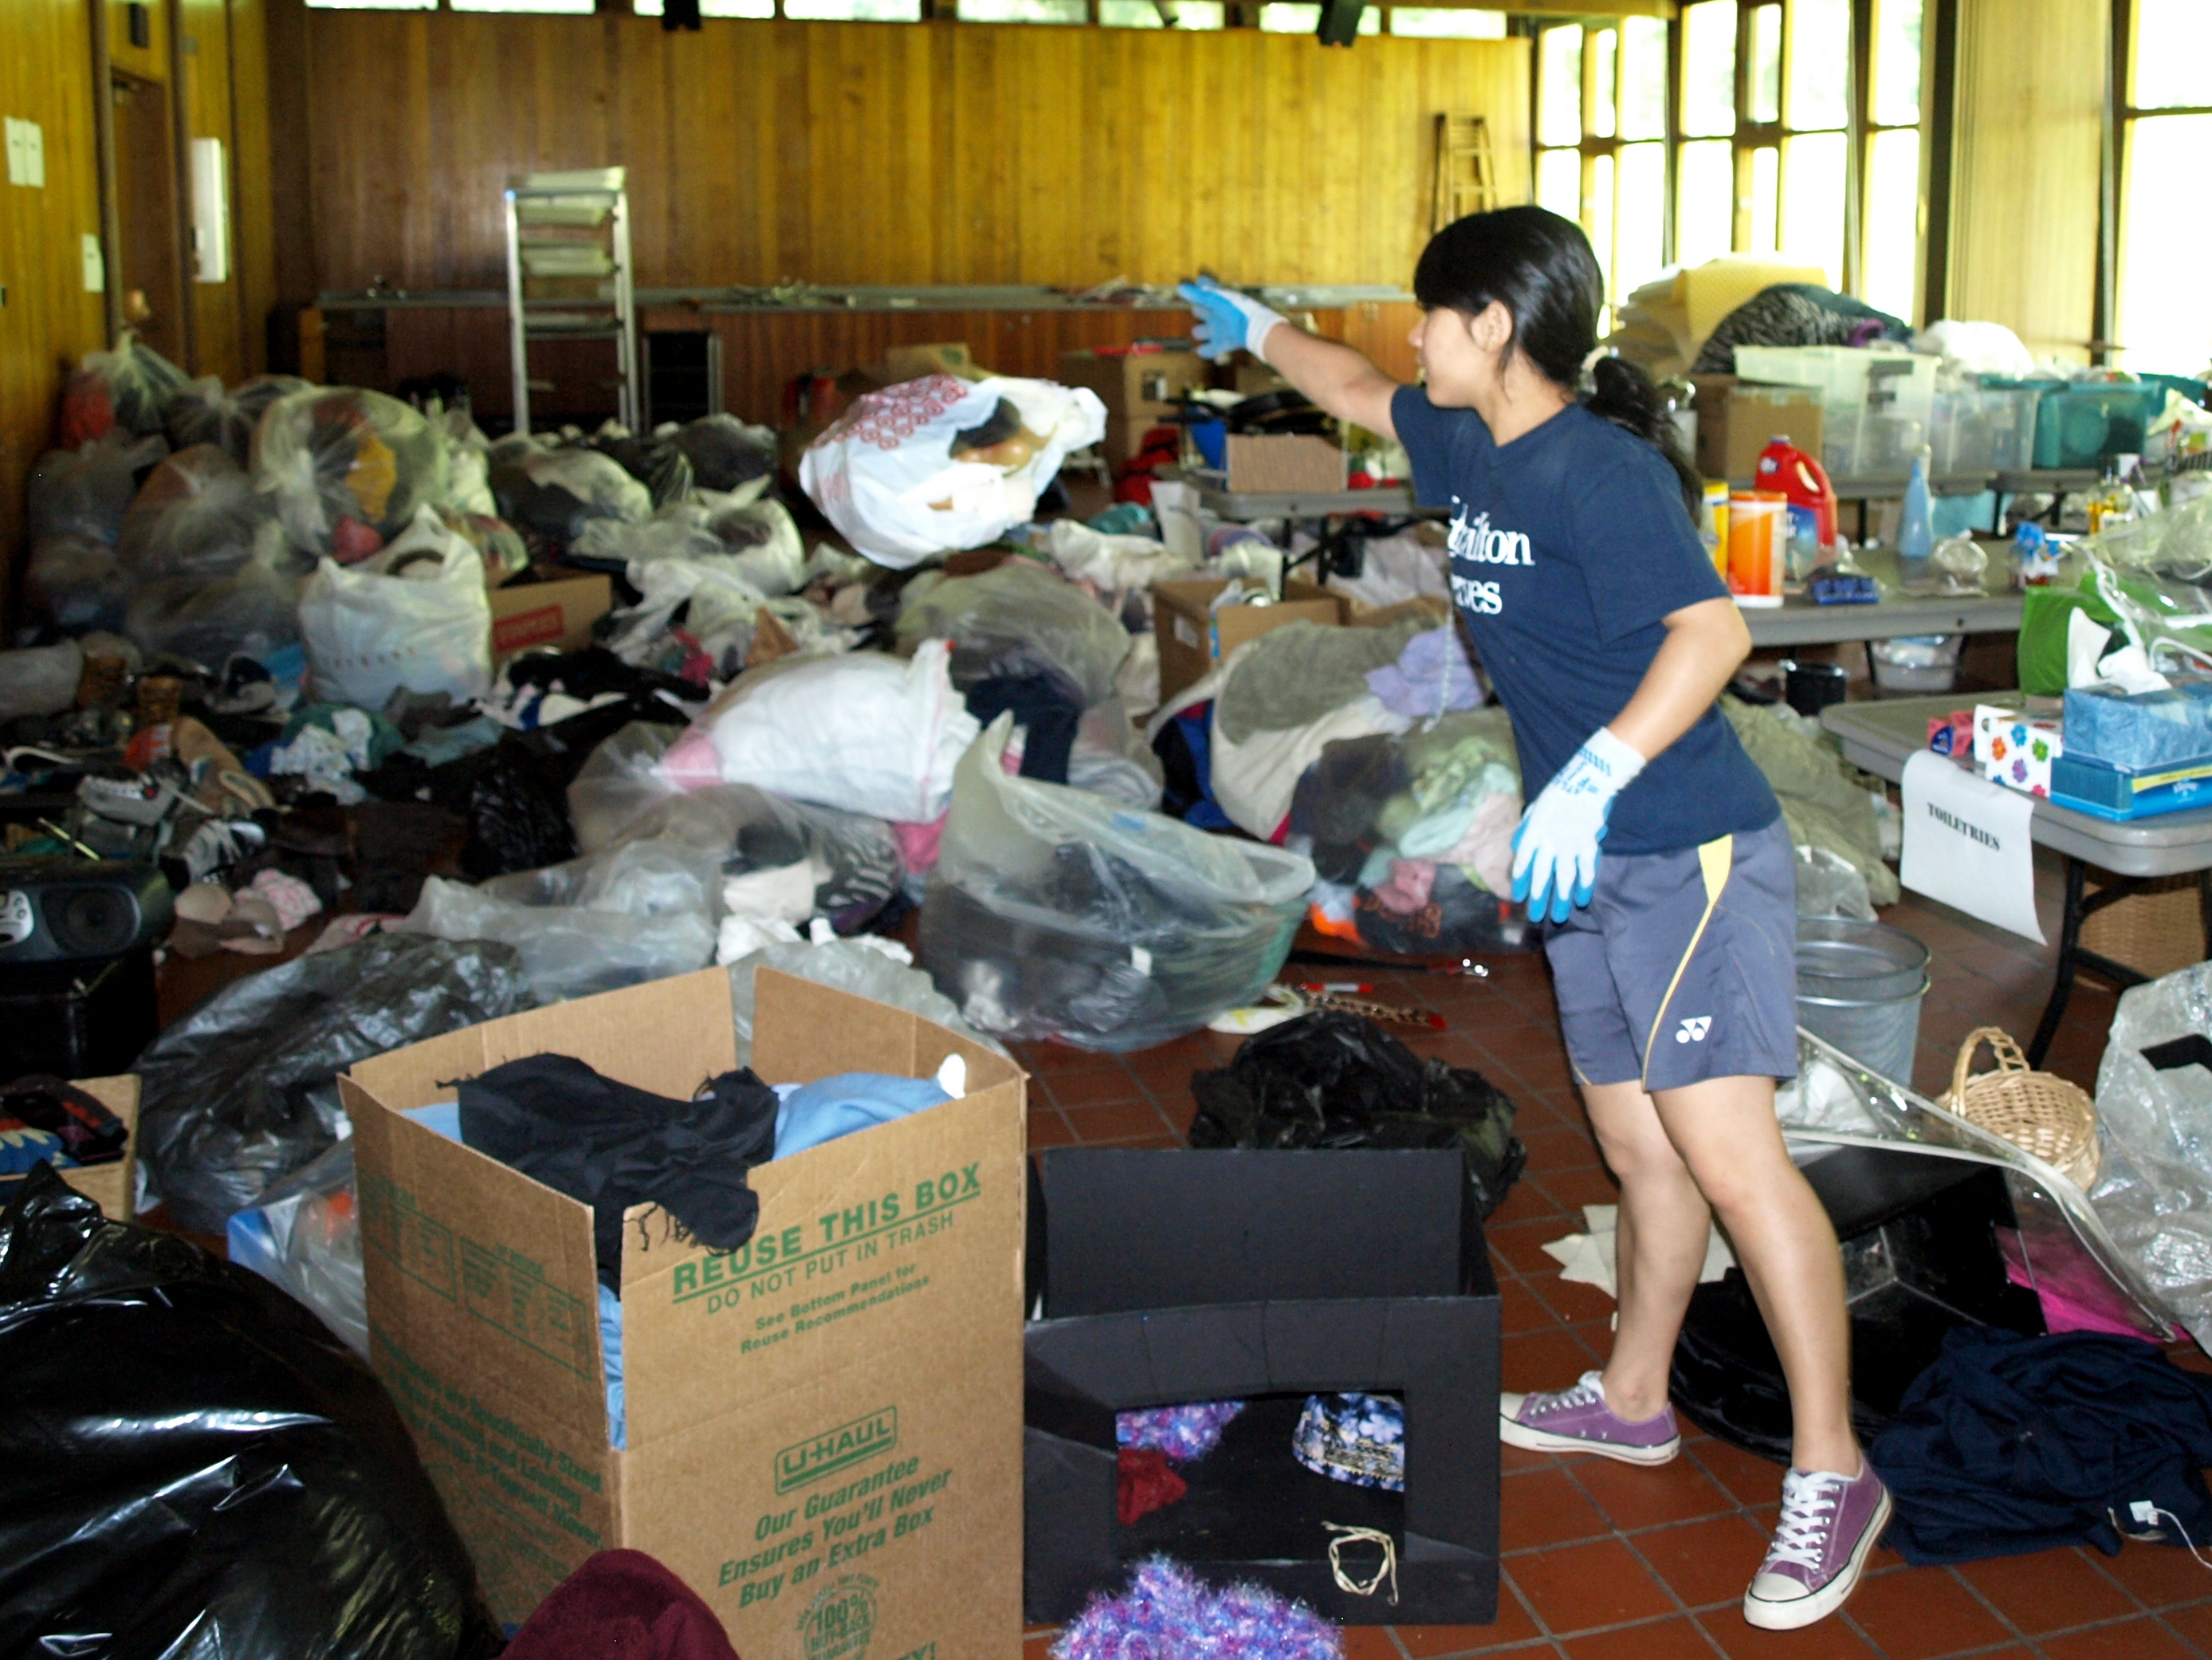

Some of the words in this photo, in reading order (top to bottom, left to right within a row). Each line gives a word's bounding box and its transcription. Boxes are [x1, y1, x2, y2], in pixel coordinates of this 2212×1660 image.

[1927, 802, 2000, 851] TOILETRIES
[674, 1225, 802, 1296] REUSE
[819, 1193, 900, 1243] THIS
[915, 1162, 980, 1210] BOX
[708, 1288, 740, 1315] DO
[751, 1268, 797, 1300] NOT
[806, 1249, 850, 1280] PUT
[857, 1238, 877, 1261] IN
[888, 1211, 954, 1249] TRASH
[741, 1329, 789, 1354] Reuse
[796, 1276, 930, 1334] Recommendations
[756, 1312, 784, 1331] See
[791, 1289, 845, 1318] Bottom
[851, 1273, 891, 1296] Panel
[896, 1264, 917, 1280] for
[783, 1418, 890, 1474] U-HAUL
[719, 1531, 814, 1587] Ensures
[823, 1495, 884, 1542] You'll
[889, 1469, 953, 1512] Never
[755, 1509, 797, 1542] Our
[804, 1456, 919, 1520] Guarantee
[739, 1572, 786, 1609] Buy
[791, 1557, 821, 1585] an
[828, 1528, 886, 1568] Extra
[894, 1506, 934, 1538] Box
[813, 1594, 870, 1633] 100%
